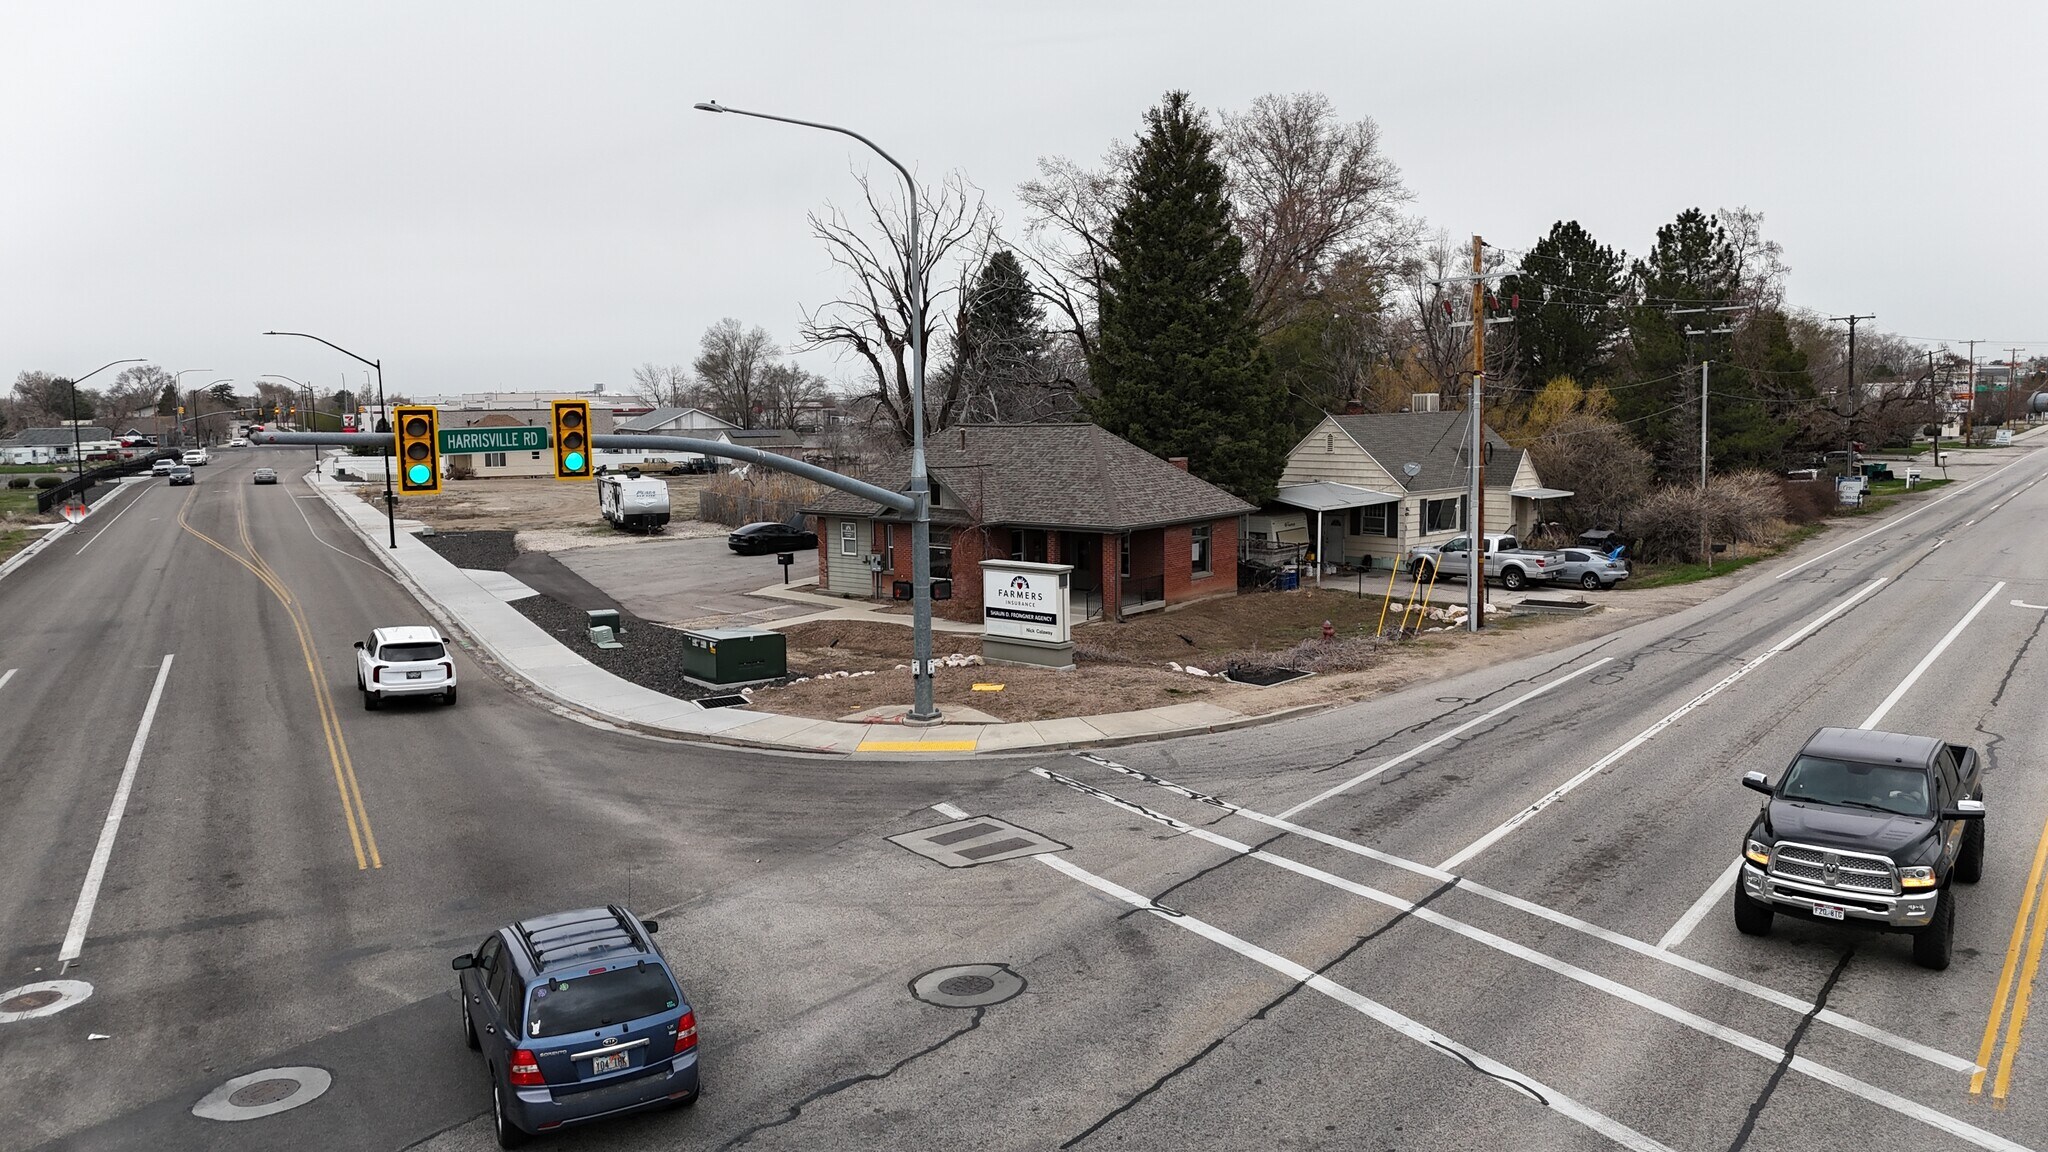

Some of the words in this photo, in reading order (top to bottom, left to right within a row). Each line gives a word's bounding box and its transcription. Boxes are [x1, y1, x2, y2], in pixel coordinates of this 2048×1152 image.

[447, 432, 519, 449] HARRISVILLE
[523, 431, 538, 447] RD
[998, 589, 1043, 601] FARMERS
[1005, 600, 1036, 608] INSURANCE
[1035, 614, 1053, 622] AGENCY
